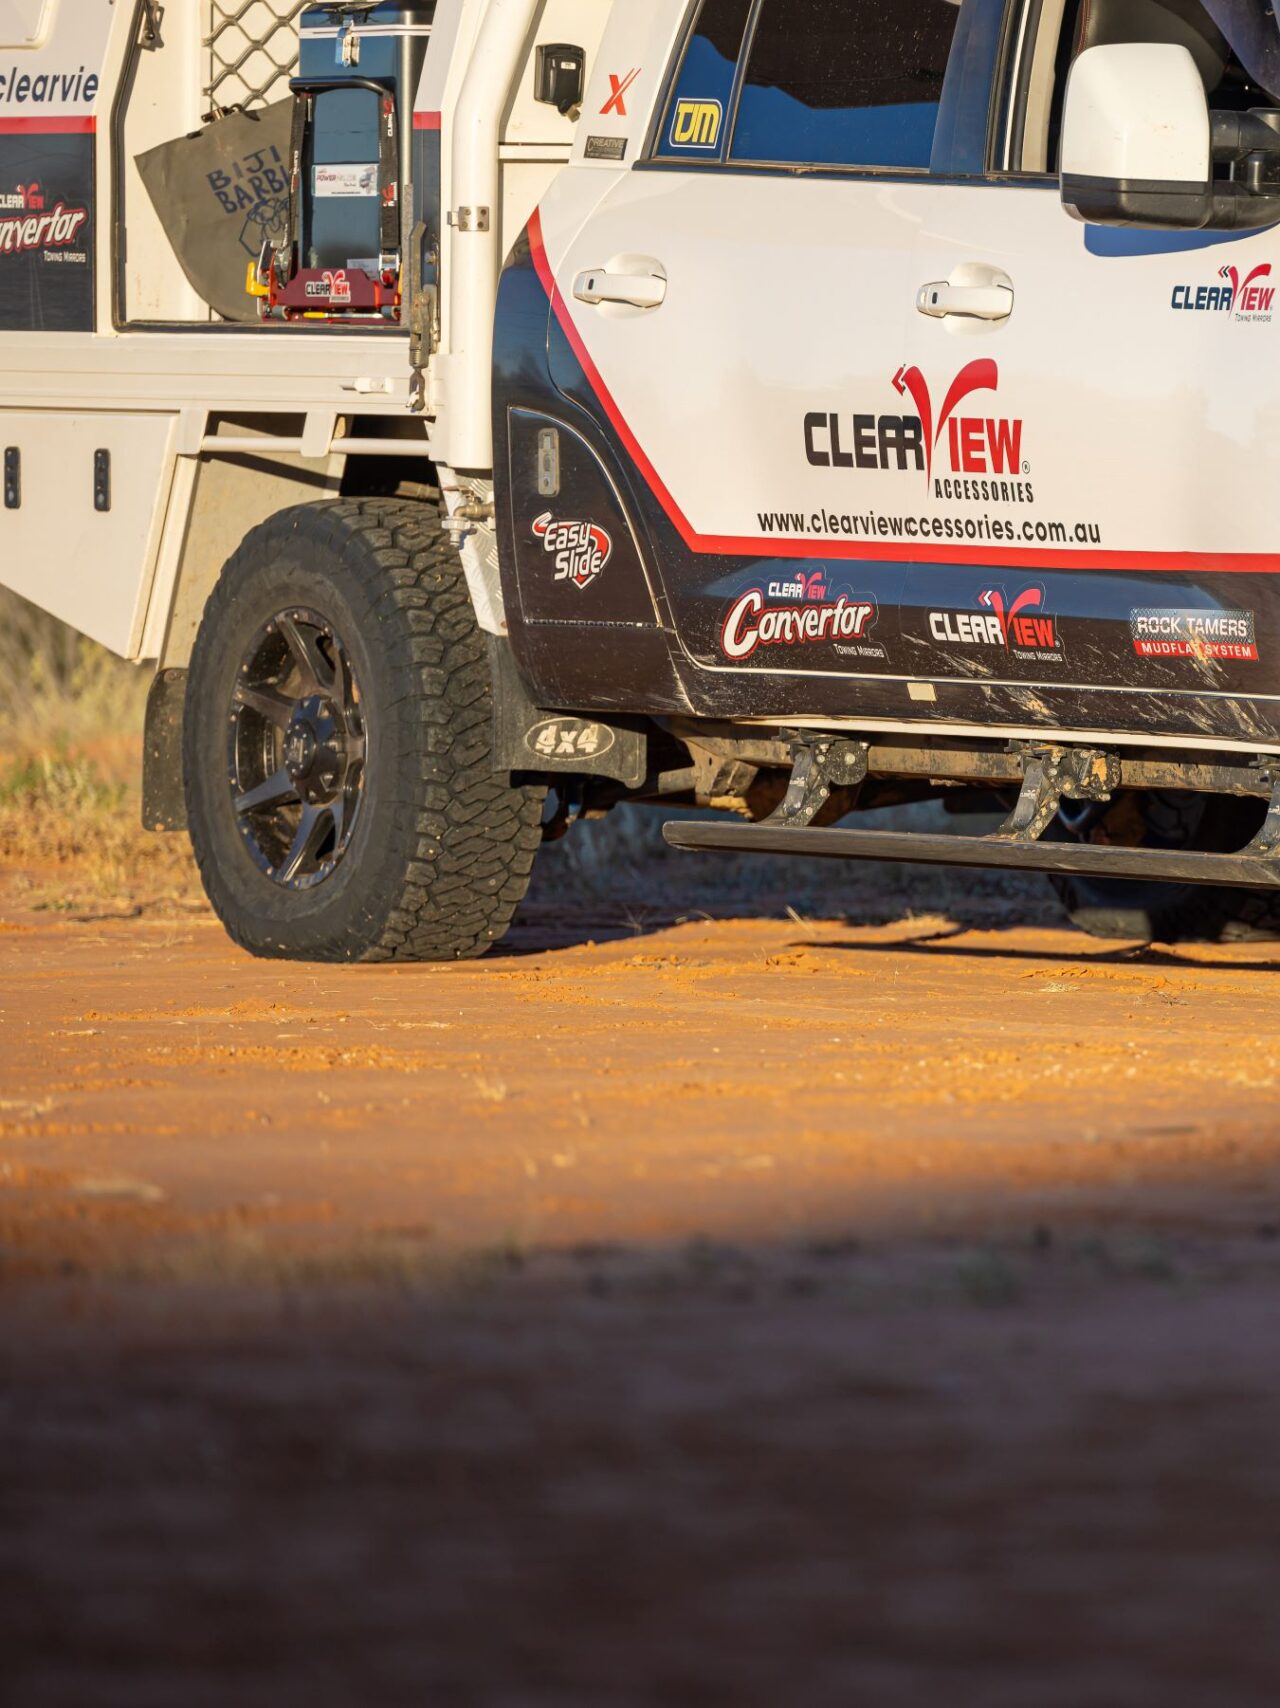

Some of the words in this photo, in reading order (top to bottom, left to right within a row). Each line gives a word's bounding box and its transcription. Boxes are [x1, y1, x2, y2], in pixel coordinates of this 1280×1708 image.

[1171, 263, 1275, 320] CLEARVIEW
[803, 358, 1023, 498] CLEARVIEW
[934, 478, 1034, 503] ACCESSORIES
[544, 522, 591, 553] Easy
[554, 546, 602, 580] Slide
[768, 572, 827, 602] CLEARVIEW
[721, 589, 873, 658] Convertor
[929, 588, 1056, 655] CLEARVIEW
[1137, 617, 1182, 633] ROCK
[1186, 618, 1247, 637] TAMERS
[1205, 644, 1252, 657] SYSTEM
[535, 725, 599, 754] 4x4
